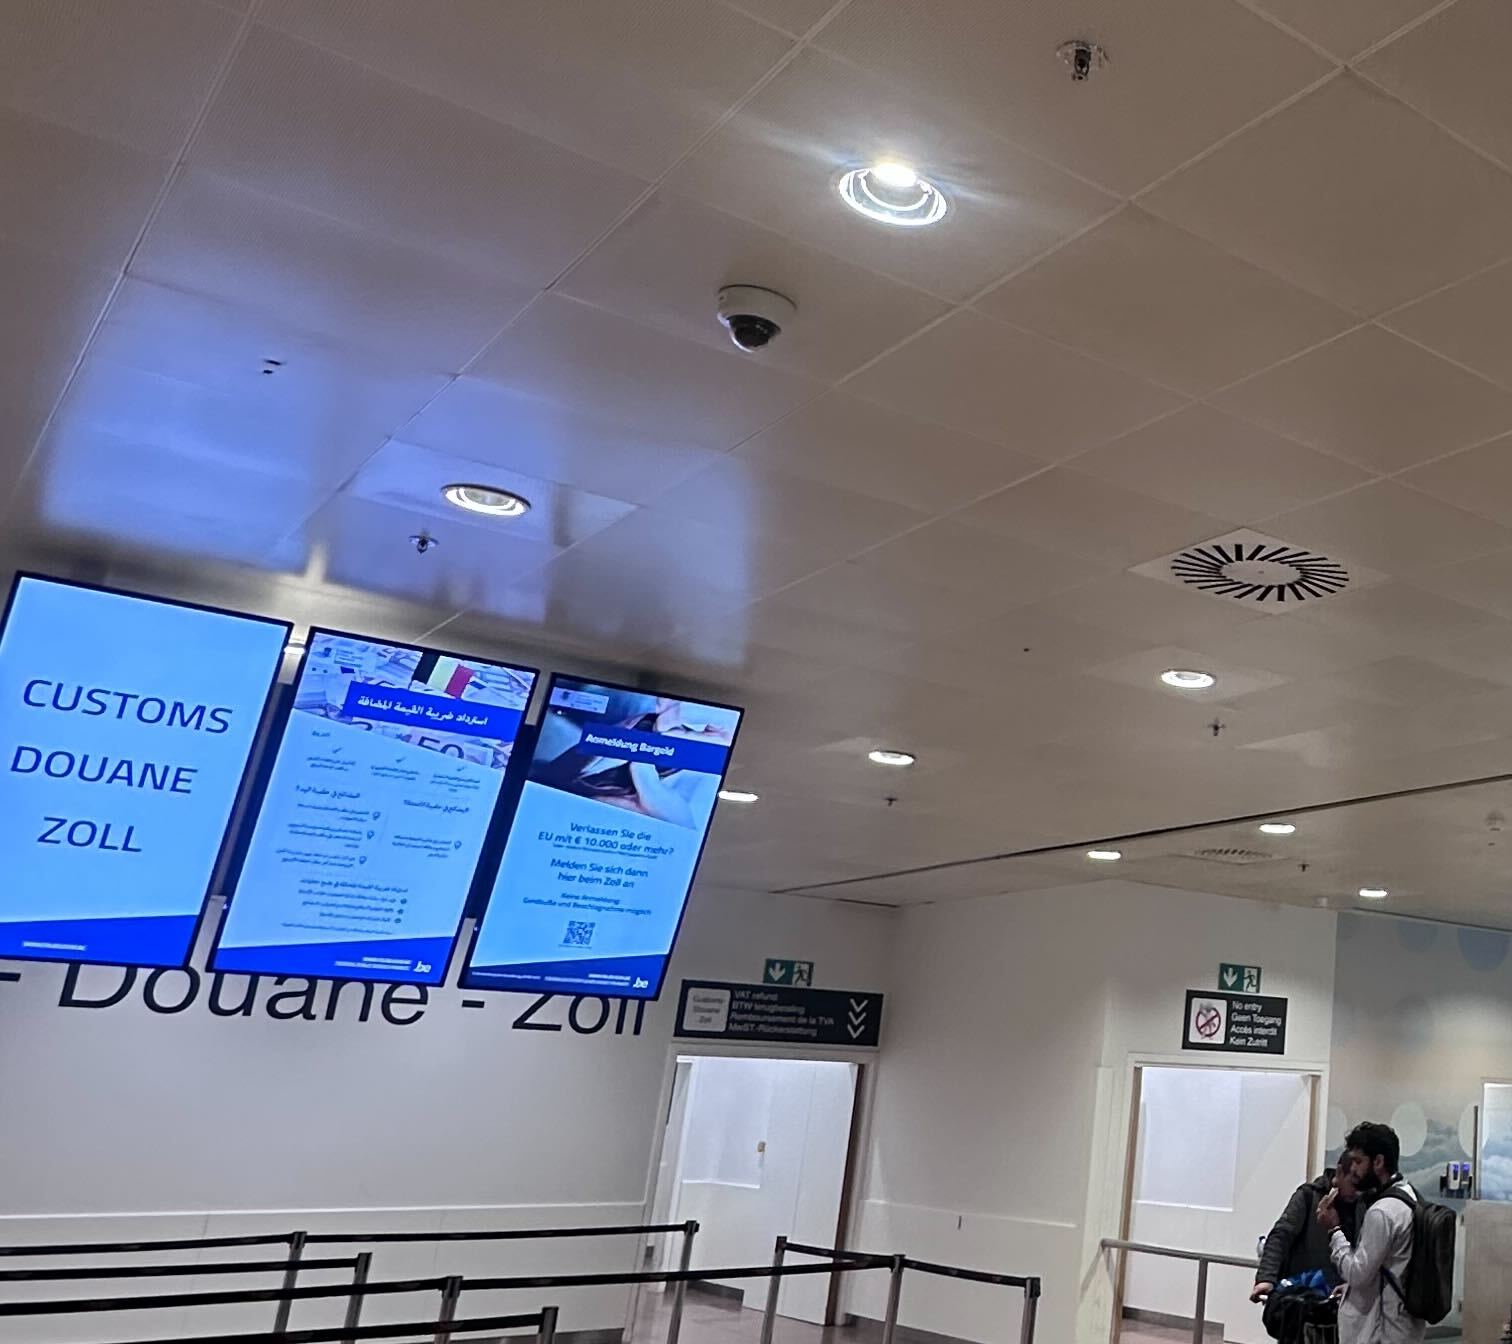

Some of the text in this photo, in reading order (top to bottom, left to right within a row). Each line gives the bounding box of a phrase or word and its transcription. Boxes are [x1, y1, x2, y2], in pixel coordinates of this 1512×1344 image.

[23, 679, 234, 734] CUSTOMS
[585, 733, 675, 756] Anmeldung Bargeld
[10, 745, 199, 794] DOUANE
[37, 816, 142, 853] ZOLL
[570, 822, 652, 841] Verlassen Sie die
[538, 831, 553, 841] EU
[554, 834, 572, 844] mit
[584, 836, 618, 849] 10.000
[620, 840, 643, 853] oder
[644, 845, 675, 856] mehr?
[550, 858, 649, 878] Melden Sie sich dann
[558, 871, 635, 889] hier beim Zoll an
[1232, 1000, 1262, 1013] No entry
[1252, 1013, 1282, 1027] Toegang
